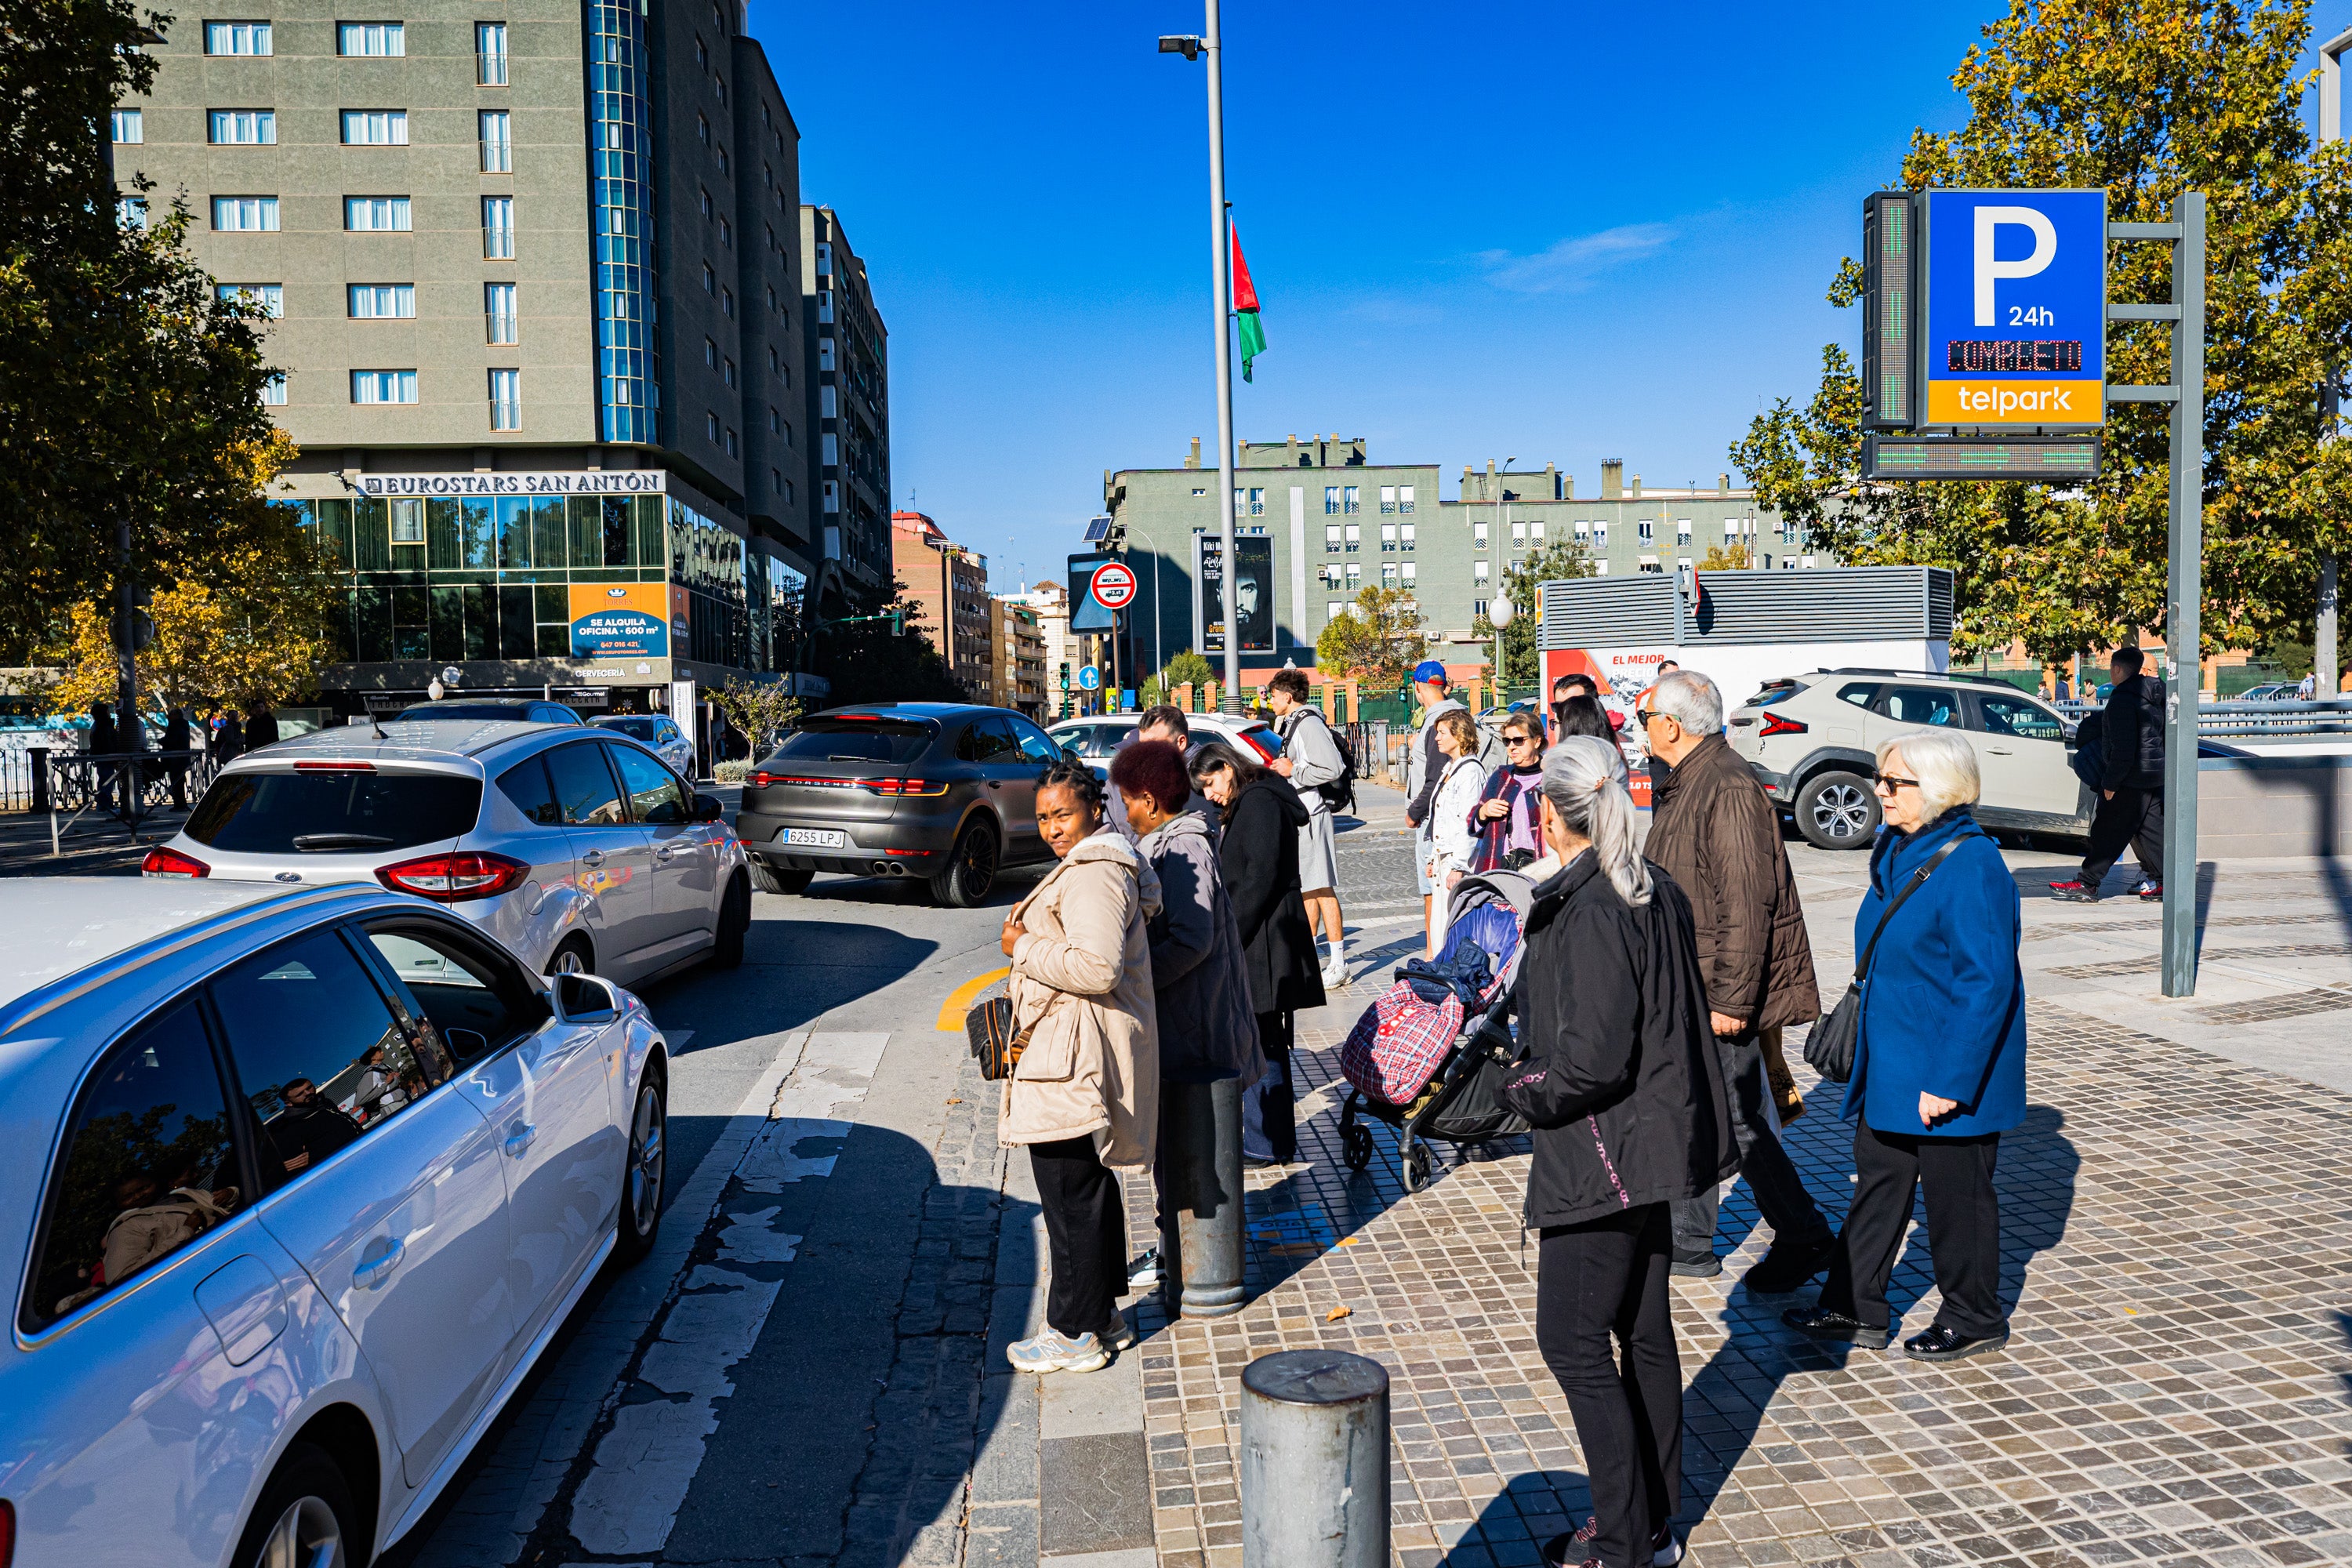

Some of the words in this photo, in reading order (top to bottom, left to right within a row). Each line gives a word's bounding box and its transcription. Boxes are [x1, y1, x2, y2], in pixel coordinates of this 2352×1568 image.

[1974, 206, 2057, 326] P
[2009, 306, 2054, 326] 24h
[1958, 387, 2072, 416] telpark
[386, 475, 518, 494] EUROSTARS
[526, 474, 571, 492] SAN
[576, 472, 659, 491] ANTÓN
[1203, 542, 1214, 551] Kiki
[604, 618, 646, 626] ALQUILA
[579, 627, 619, 636] OFICINA
[625, 626, 644, 635] 600
[1209, 624, 1225, 633] Grana
[1613, 655, 1625, 665] EL
[1628, 654, 1664, 664] MEJOR
[575, 667, 626, 677] CERVECERÍA
[1612, 668, 1655, 679] PRECIO
[790, 831, 816, 843] 6255
[820, 833, 842, 845] LPJ
